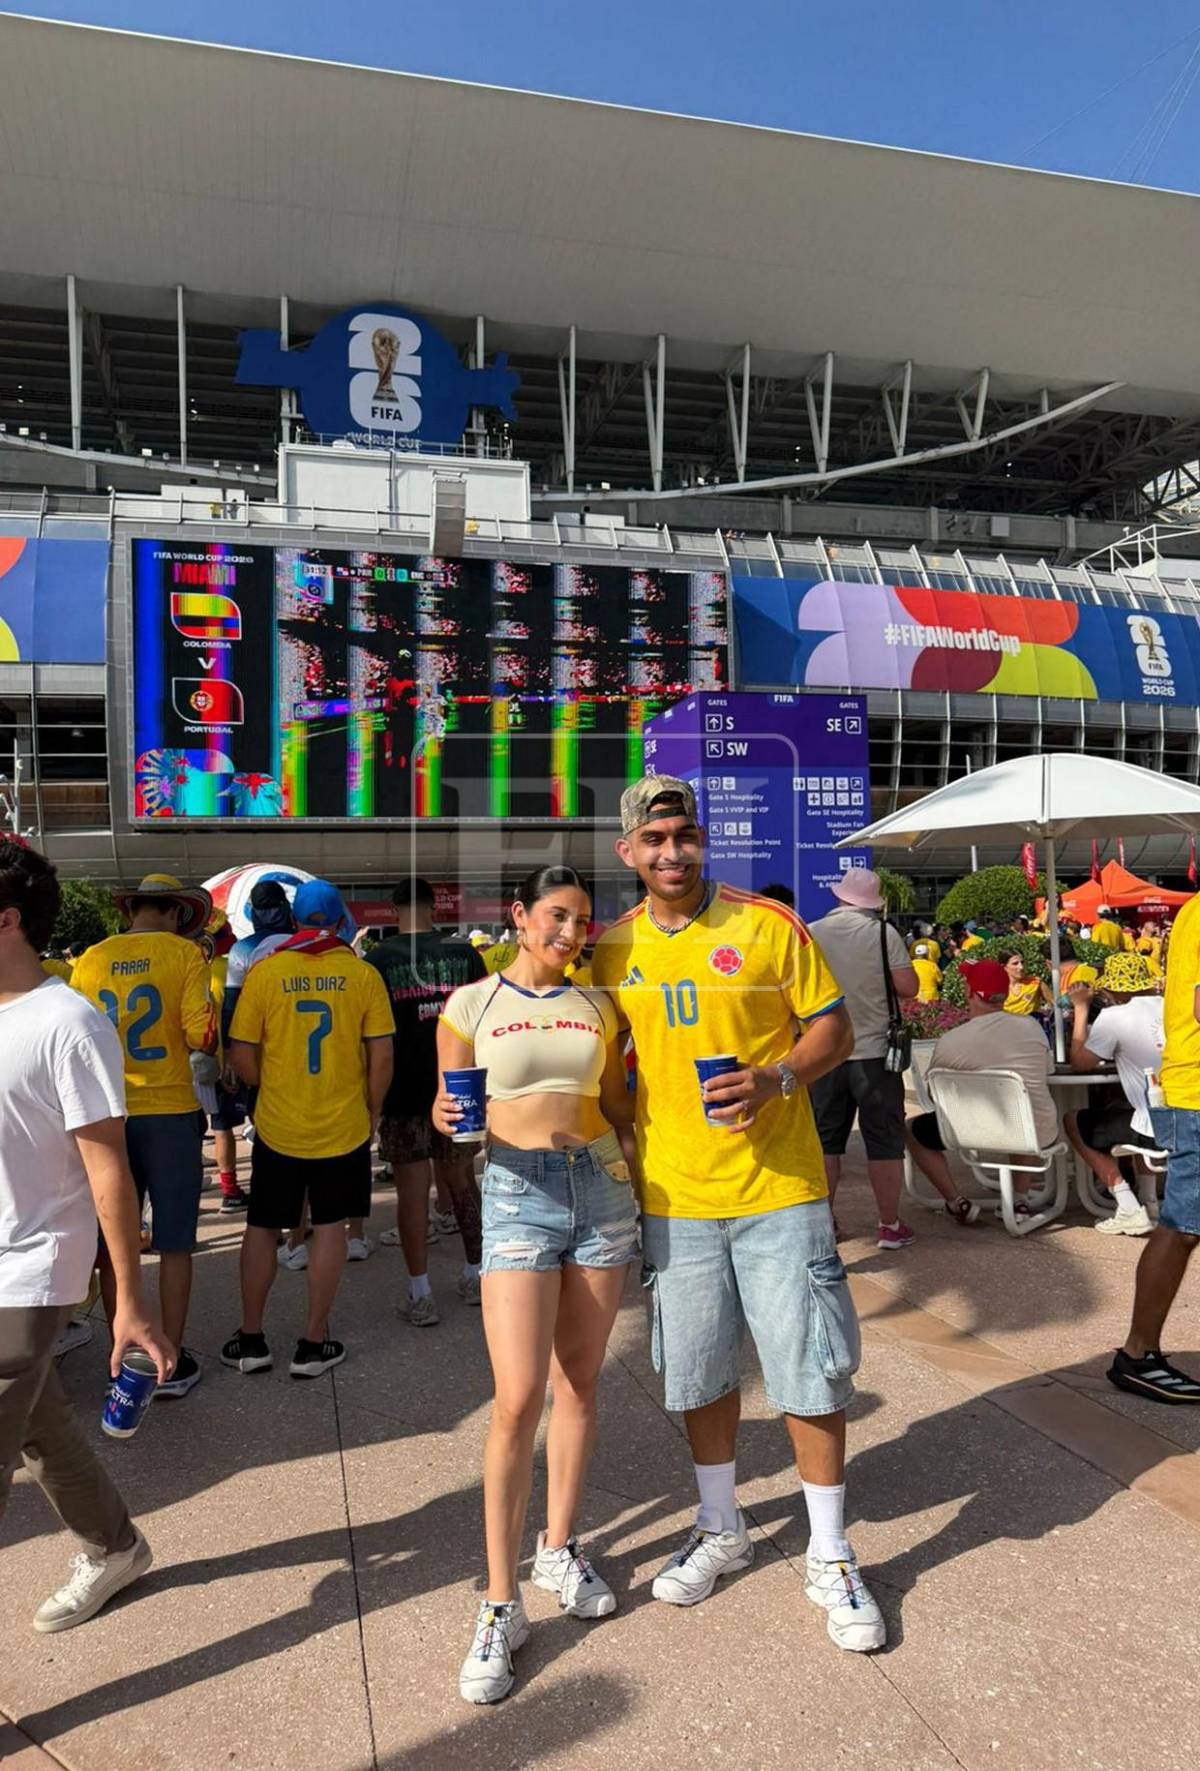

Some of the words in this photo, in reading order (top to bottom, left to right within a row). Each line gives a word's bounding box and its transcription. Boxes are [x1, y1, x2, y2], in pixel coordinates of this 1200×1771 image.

[371, 406, 403, 422] FIFA
[349, 432, 394, 446] WORLD
[173, 553, 204, 561] WORLD
[884, 623, 1021, 656] #FIFAWorldCup
[1143, 685, 1175, 696] 2026
[774, 694, 794, 703] FIFA
[184, 726, 234, 734] PORTUGAL
[725, 716, 734, 730] S
[826, 718, 842, 732] SE
[727, 742, 748, 756] SW
[730, 793, 764, 802] Hospitality
[831, 809, 864, 817] Hospitality
[738, 852, 772, 860] Hospitality
[111, 958, 150, 976] PARRA
[282, 977, 310, 993] LUIS
[315, 976, 347, 992] DIAZ
[660, 979, 699, 1028] 10
[295, 999, 333, 1075] 7
